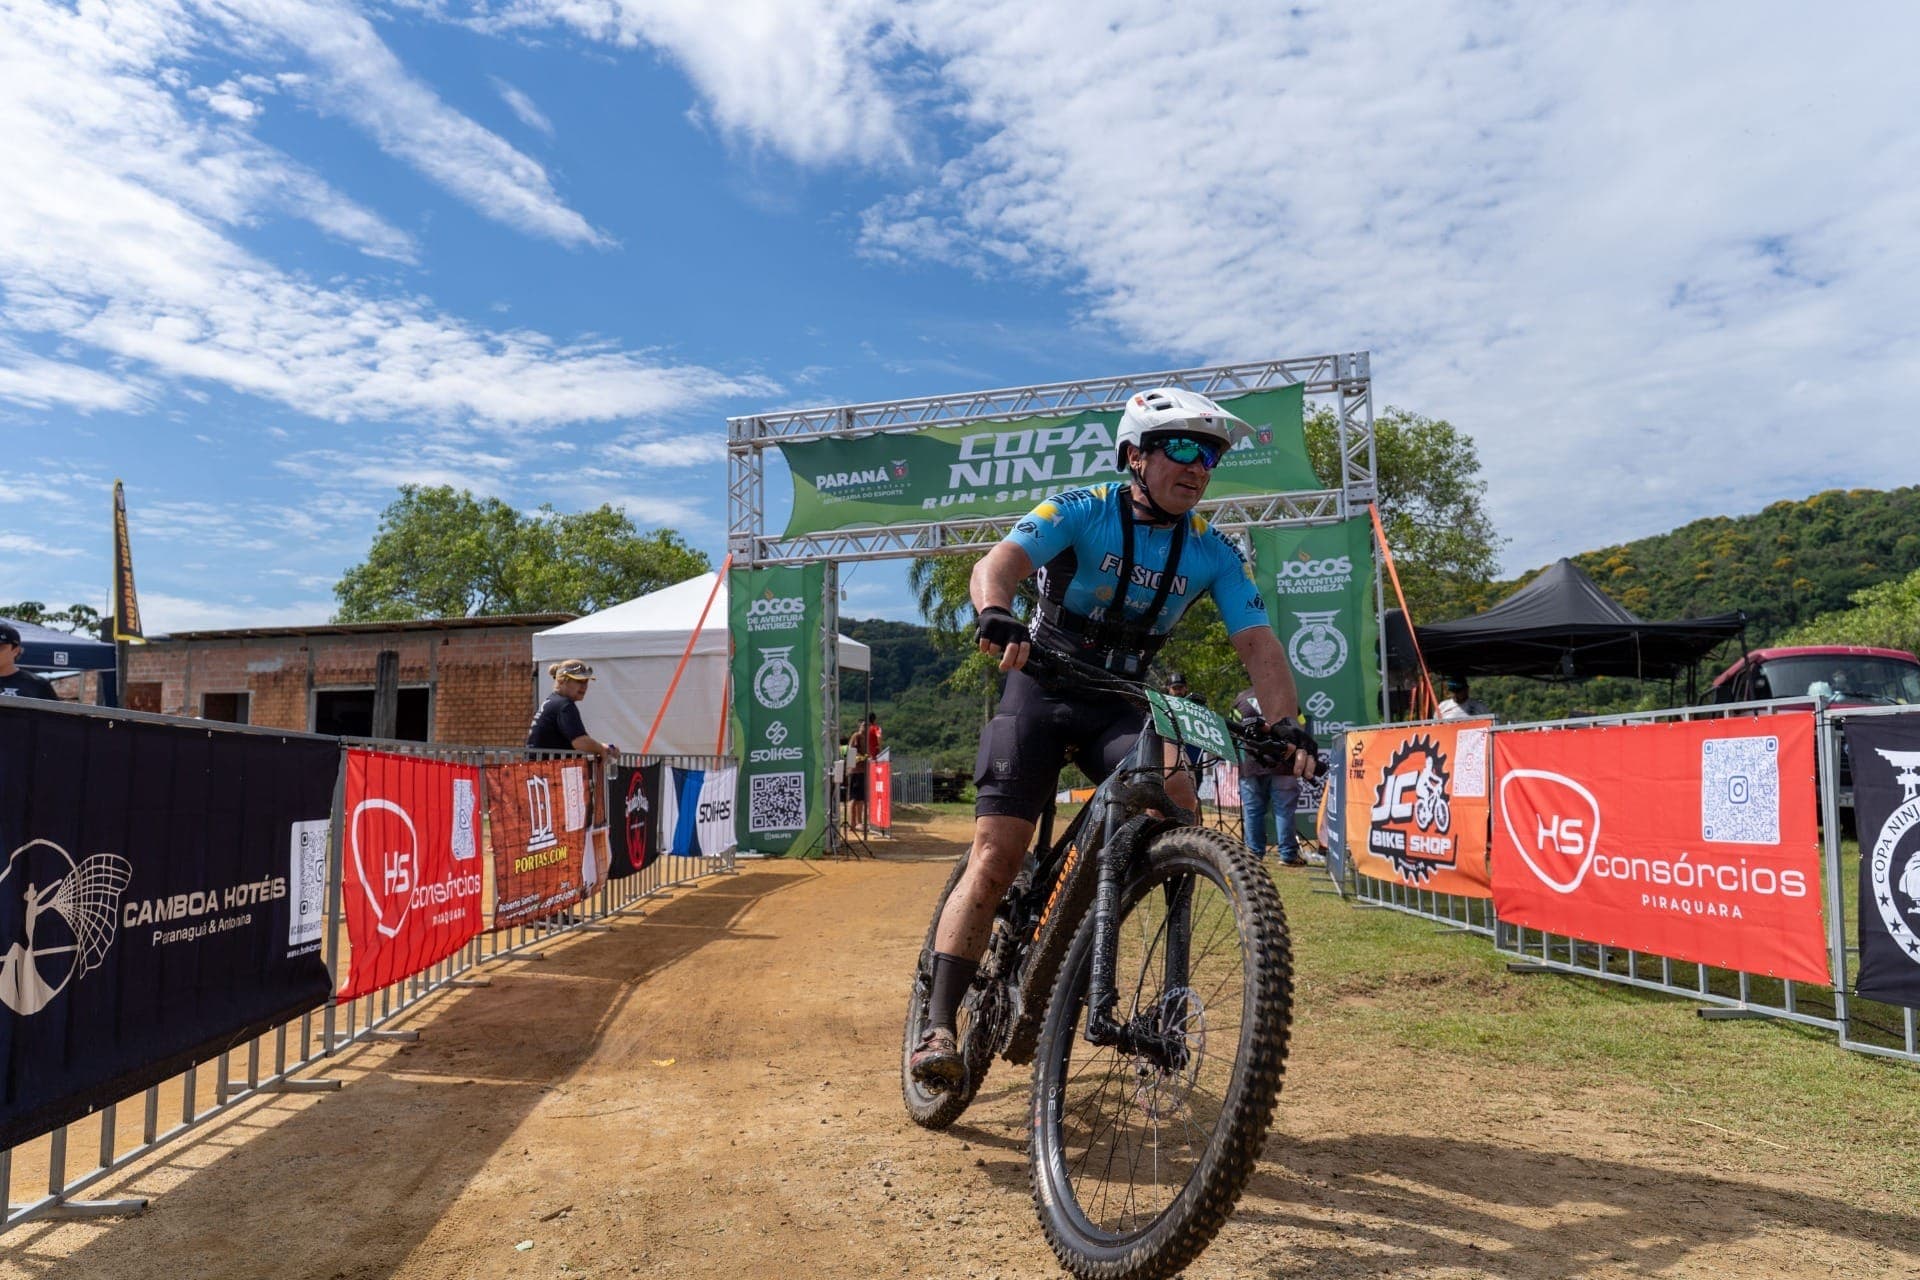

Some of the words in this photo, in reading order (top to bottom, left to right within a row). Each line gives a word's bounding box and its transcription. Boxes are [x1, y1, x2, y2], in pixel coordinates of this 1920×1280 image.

[959, 423, 1114, 460] COPA
[949, 451, 1128, 488] NINJA
[1239, 457, 1272, 466] ESPORTE
[815, 466, 890, 490] PARANÁ
[874, 489, 904, 498] ESPORTE
[922, 493, 975, 510] RUN
[1276, 556, 1353, 579] JOGOS
[1277, 579, 1292, 587] DE
[1294, 574, 1353, 586] AVENTURA
[1287, 583, 1345, 594] NATUREZA
[746, 597, 806, 617] JOGOS
[747, 617, 759, 625] DE
[760, 613, 804, 624] AVENTURA
[754, 621, 798, 631] NATUREZA
[1179, 715, 1225, 746] 108
[1313, 720, 1354, 736] lifes
[750, 747, 803, 763] solifes
[1371, 770, 1419, 822] JC
[699, 800, 731, 823] solifes
[1371, 830, 1406, 850] BIKE
[1409, 835, 1452, 856] SHOP
[1537, 813, 1585, 855] HS
[1874, 838, 1893, 884] COPA
[1887, 803, 1920, 837] NINJ
[514, 845, 568, 875] PORTAS.COM
[384, 851, 411, 896] HS
[1593, 852, 1808, 898] consórcios
[123, 889, 218, 928] CAMBOA
[224, 874, 287, 908] HOTÉIS
[411, 870, 482, 911] consórcios
[1641, 894, 1744, 920] PIRAQUARA
[152, 921, 208, 946] Paranaguá
[208, 922, 216, 934] &
